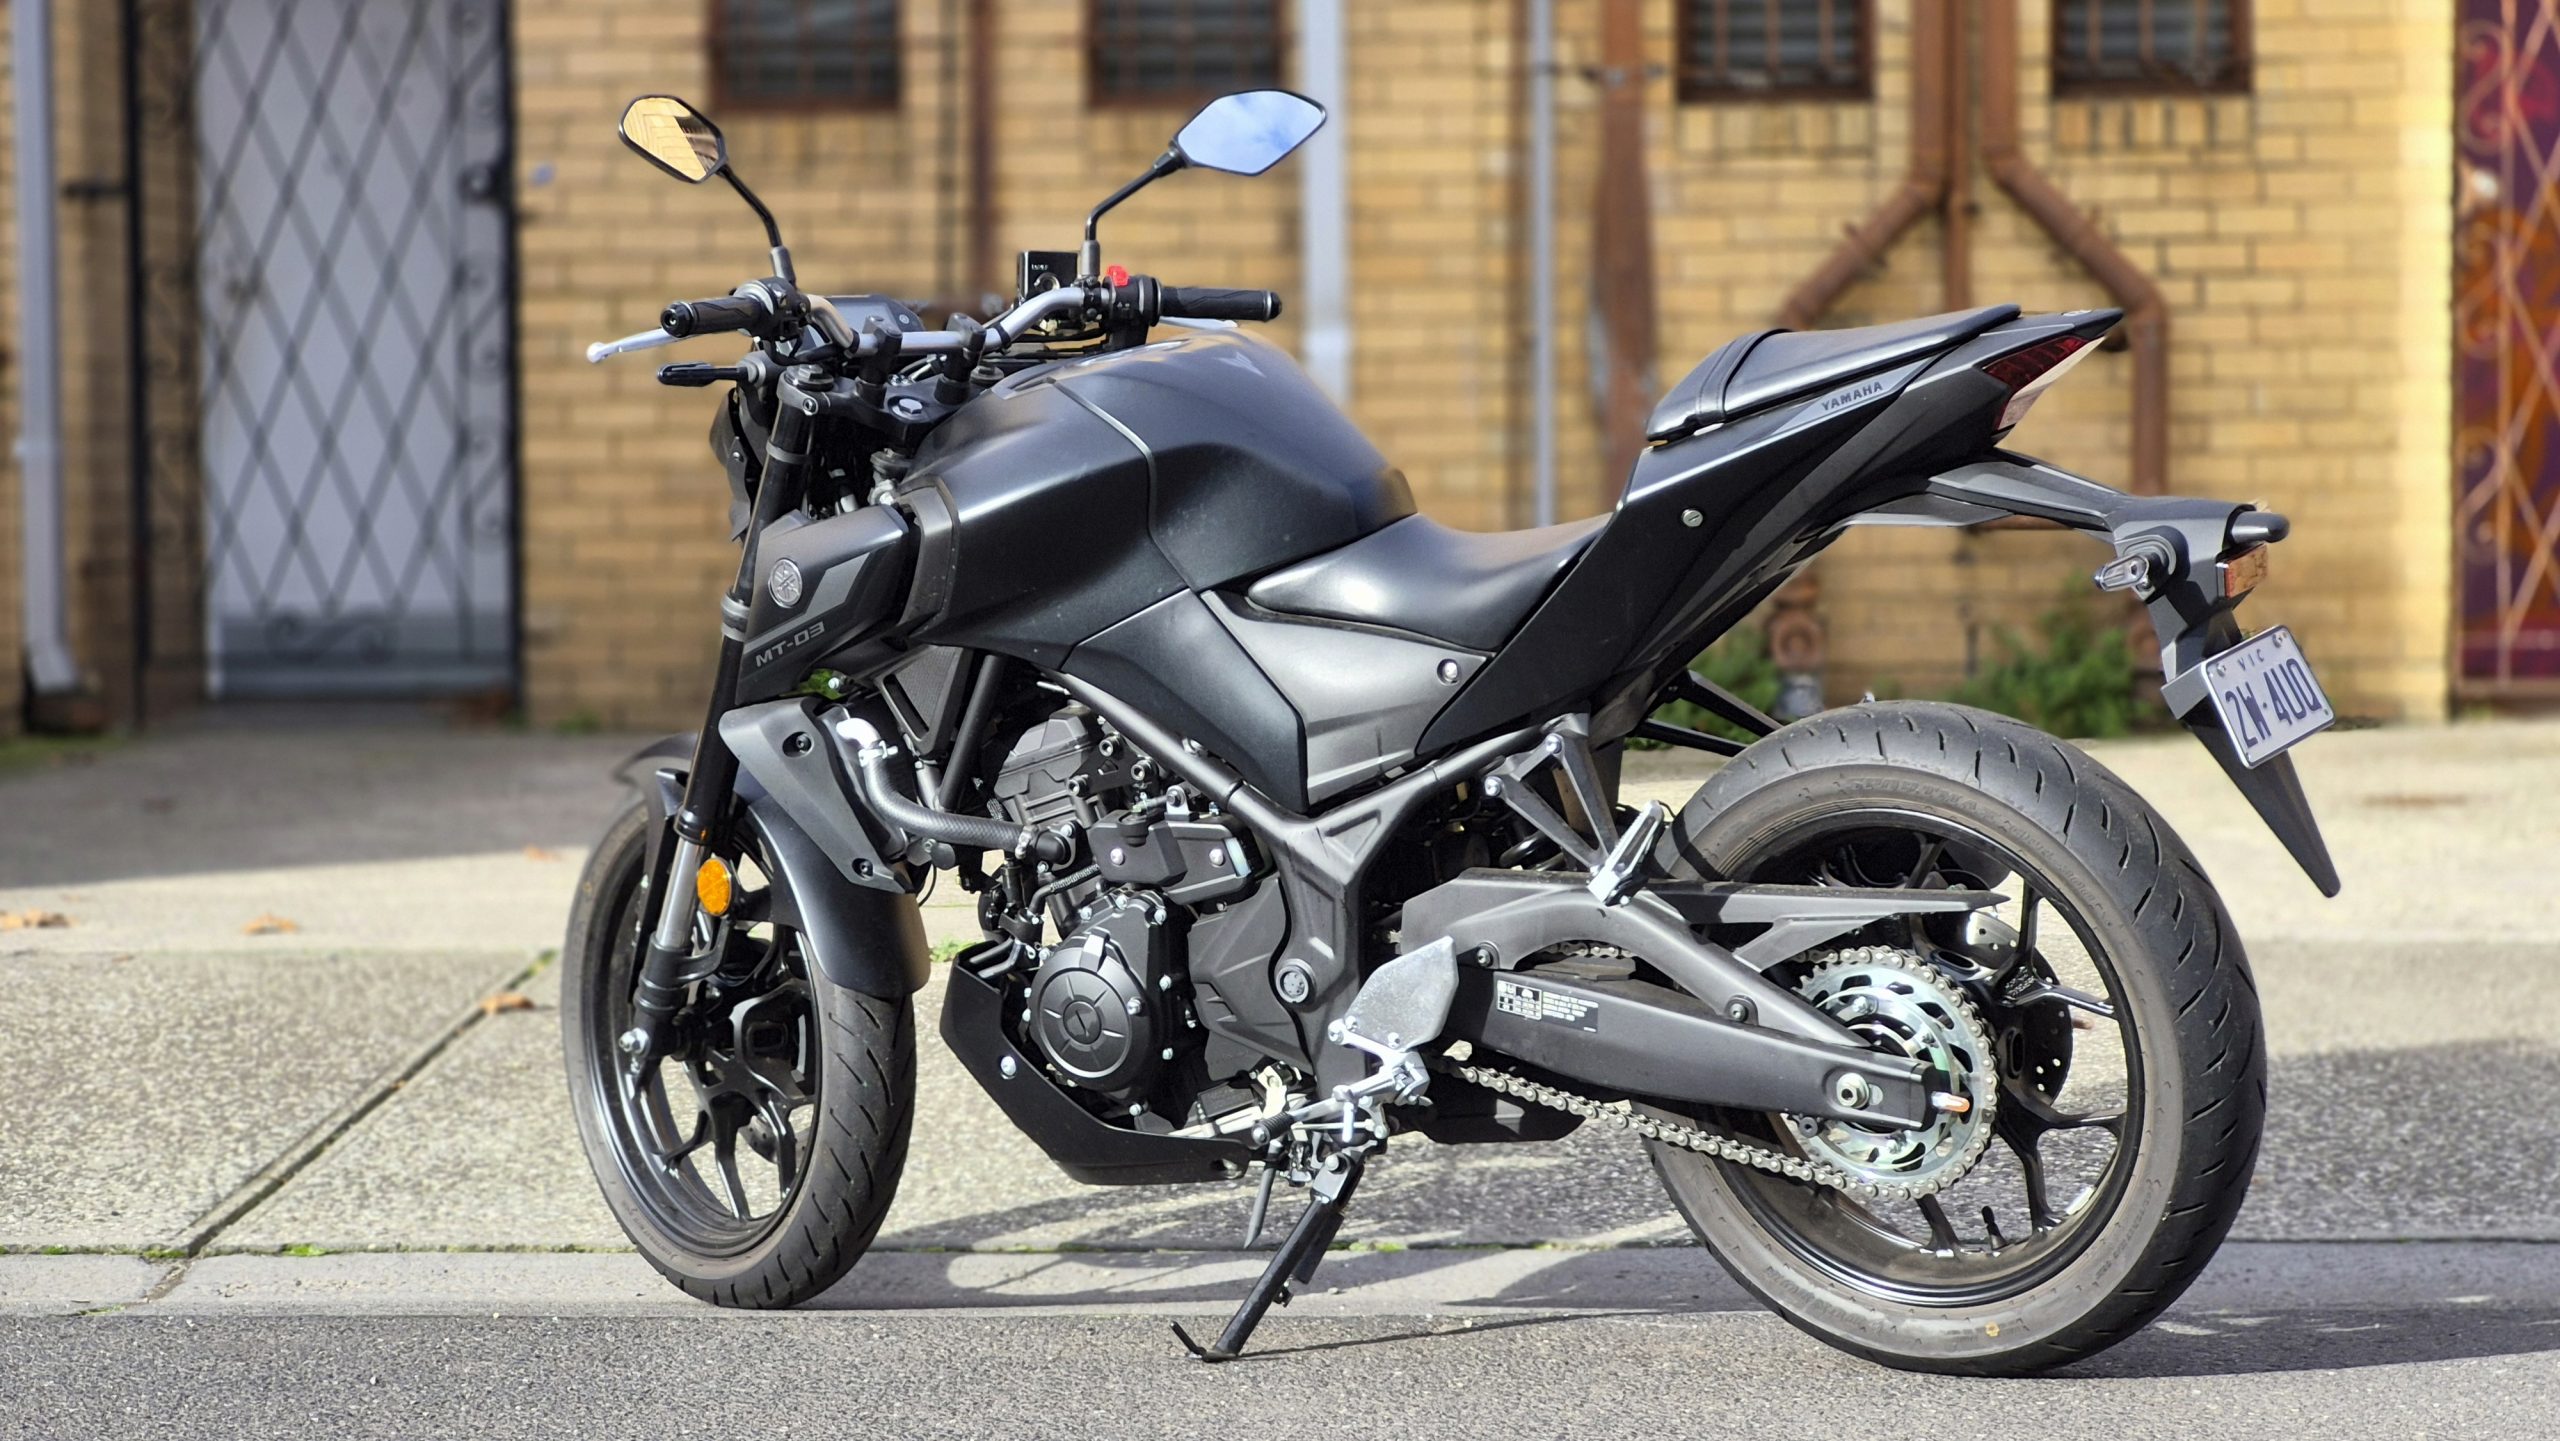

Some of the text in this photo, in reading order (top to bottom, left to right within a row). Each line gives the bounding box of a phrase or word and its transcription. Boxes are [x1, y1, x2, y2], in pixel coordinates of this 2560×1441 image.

[1821, 381, 1883, 411] YAMAHA
[755, 621, 825, 668] MT-03
[2237, 649, 2265, 671] VIC
